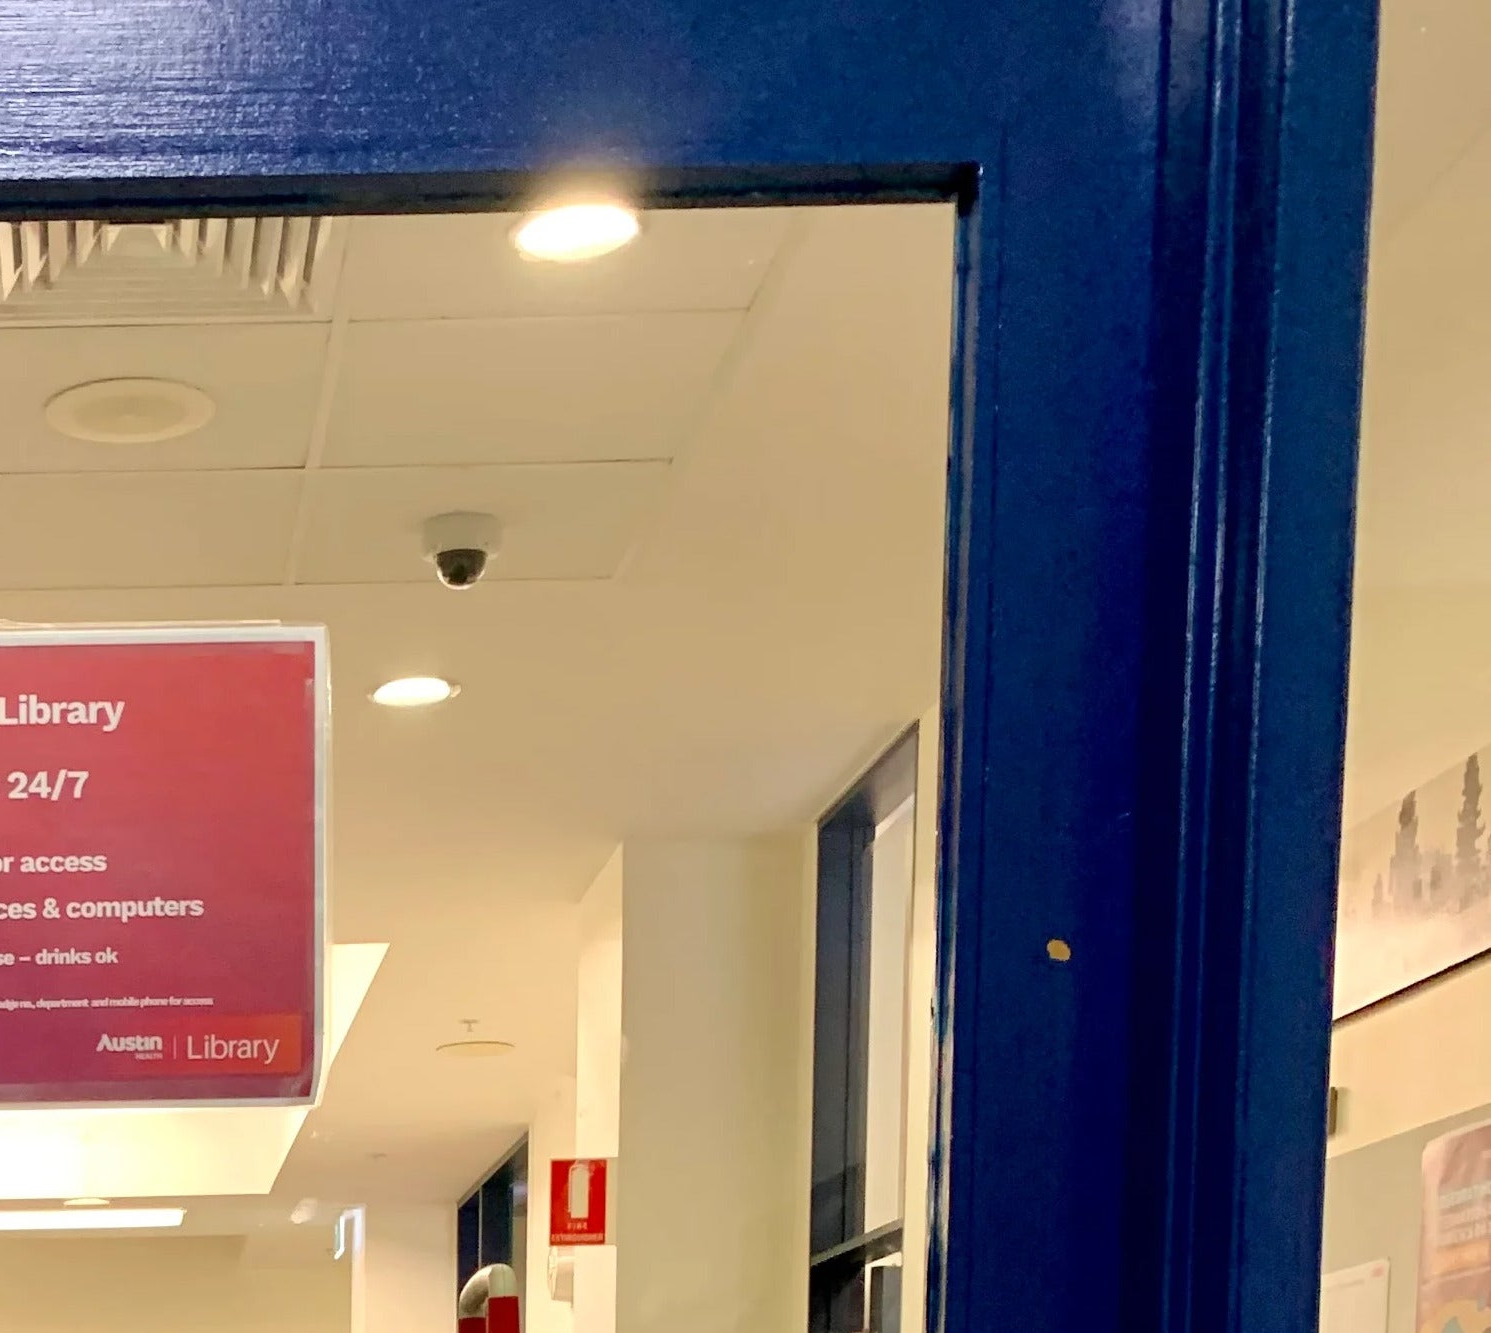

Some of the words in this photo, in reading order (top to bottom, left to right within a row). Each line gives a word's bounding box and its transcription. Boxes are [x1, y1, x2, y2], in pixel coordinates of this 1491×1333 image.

[7, 769, 89, 801] 24/7
[19, 854, 108, 873] access
[42, 897, 61, 919] &
[65, 896, 205, 922] computers
[35, 947, 92, 966] drinks
[94, 946, 119, 965] ok
[96, 1033, 163, 1052] Austin
[187, 1033, 280, 1065] Library
